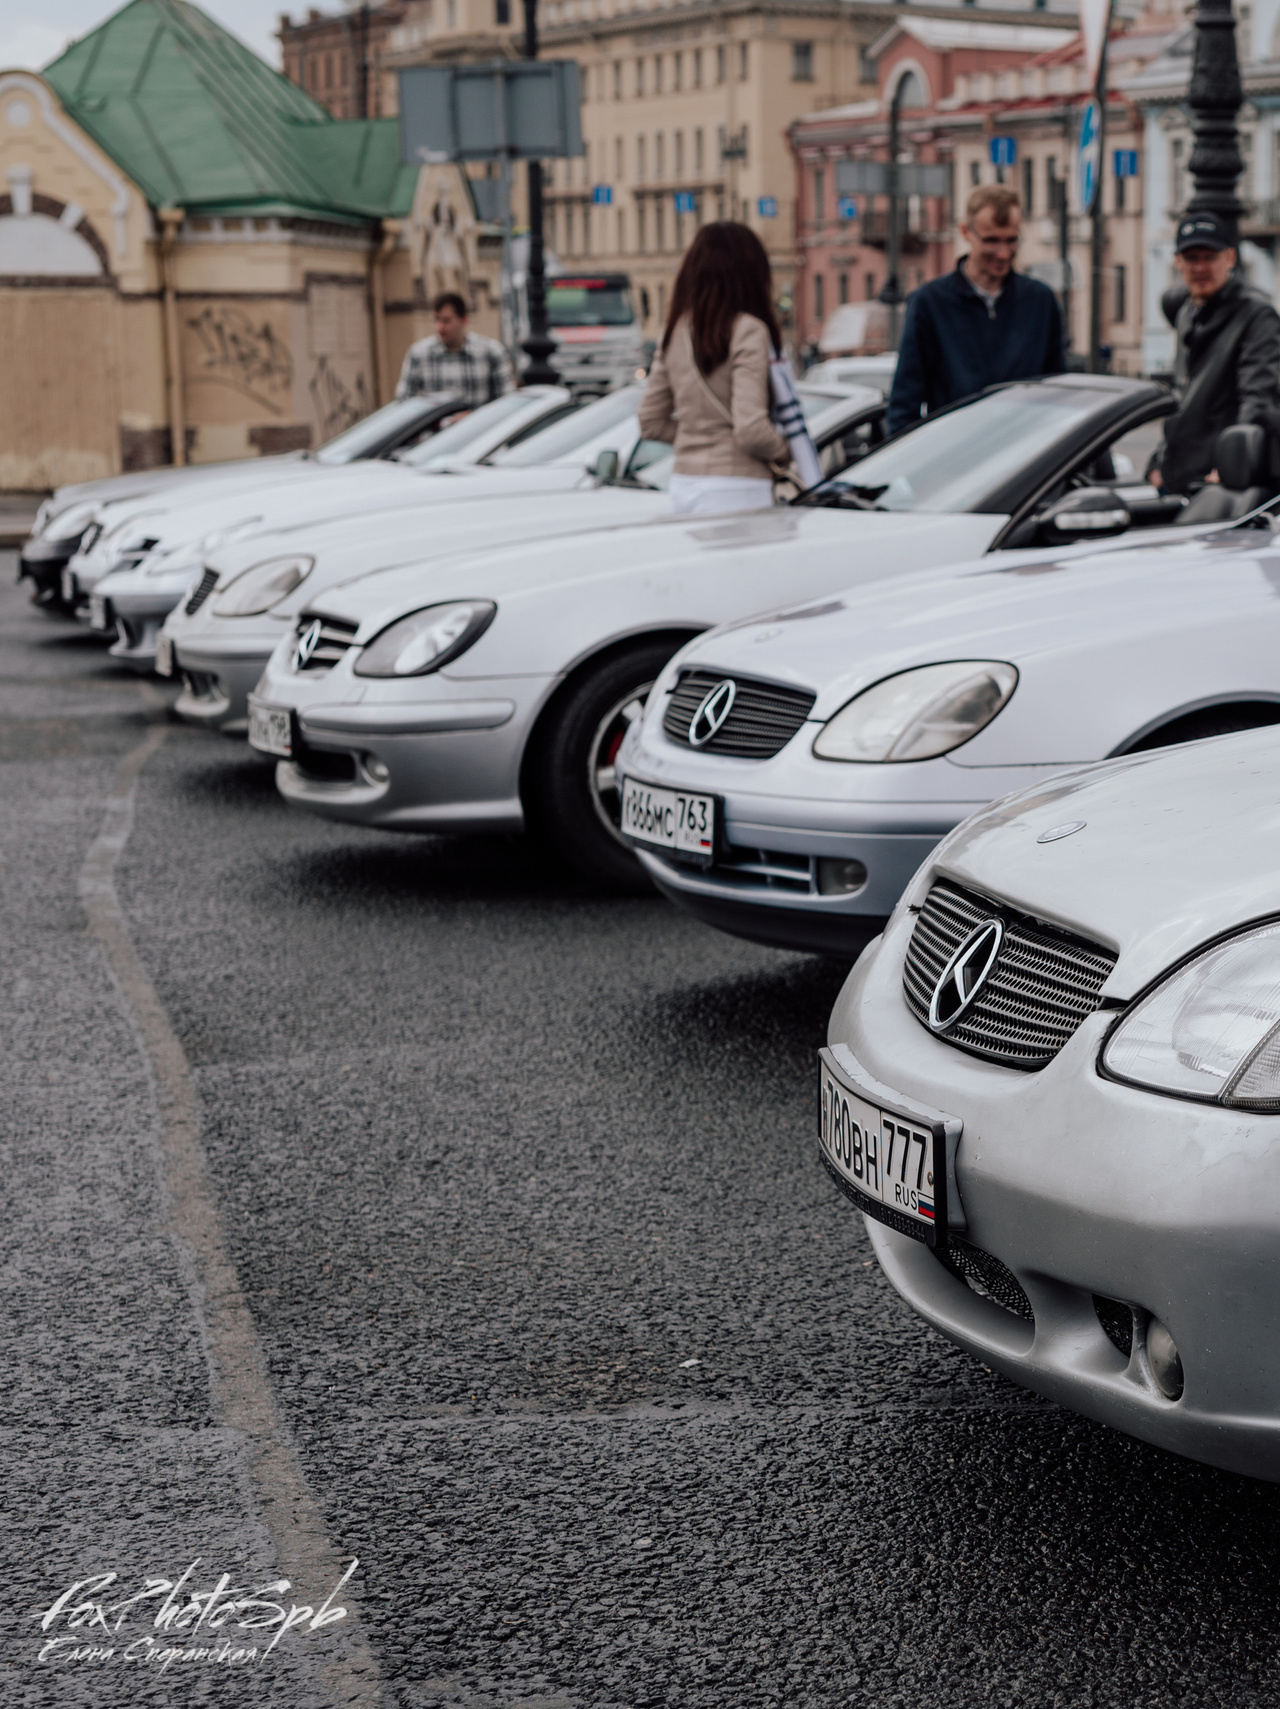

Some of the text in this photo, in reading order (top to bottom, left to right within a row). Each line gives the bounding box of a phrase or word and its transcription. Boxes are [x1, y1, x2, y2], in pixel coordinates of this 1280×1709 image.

[678, 797, 708, 832] 763
[882, 1118, 928, 1191] 777
[894, 1183, 918, 1211] RUS
